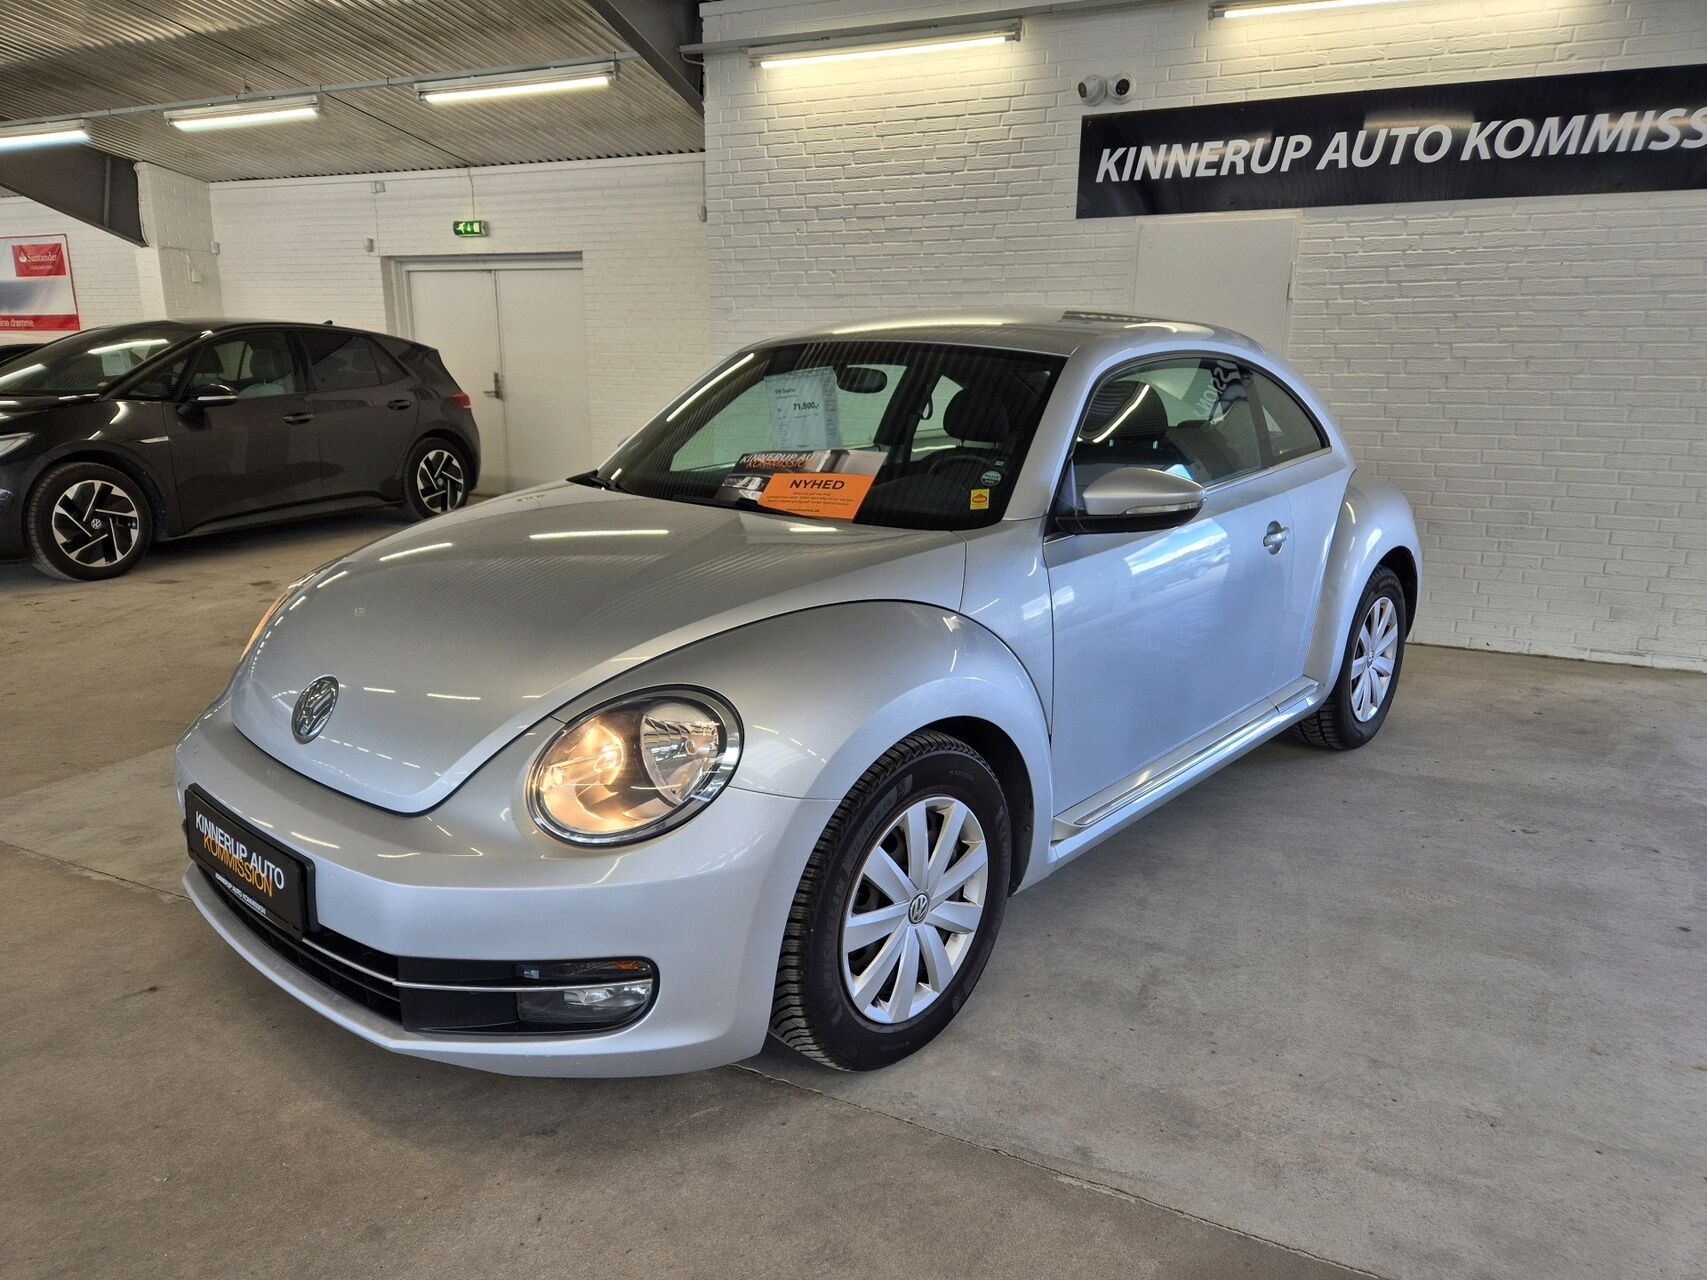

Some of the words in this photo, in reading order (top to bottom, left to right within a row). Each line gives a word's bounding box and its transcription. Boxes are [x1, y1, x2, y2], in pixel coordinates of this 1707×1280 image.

[1095, 134, 1312, 183] KINNERUP
[1315, 124, 1453, 171] AUTO
[1460, 106, 1707, 161] KOMMISS
[27, 253, 57, 263] Santander
[740, 452, 799, 463] KINNERUP
[746, 460, 810, 469] KOMMISSIO
[789, 479, 846, 490] NYHED
[195, 810, 248, 862] KINNERUP
[250, 852, 285, 890] AUTO
[204, 834, 273, 898] KOMMISSION
